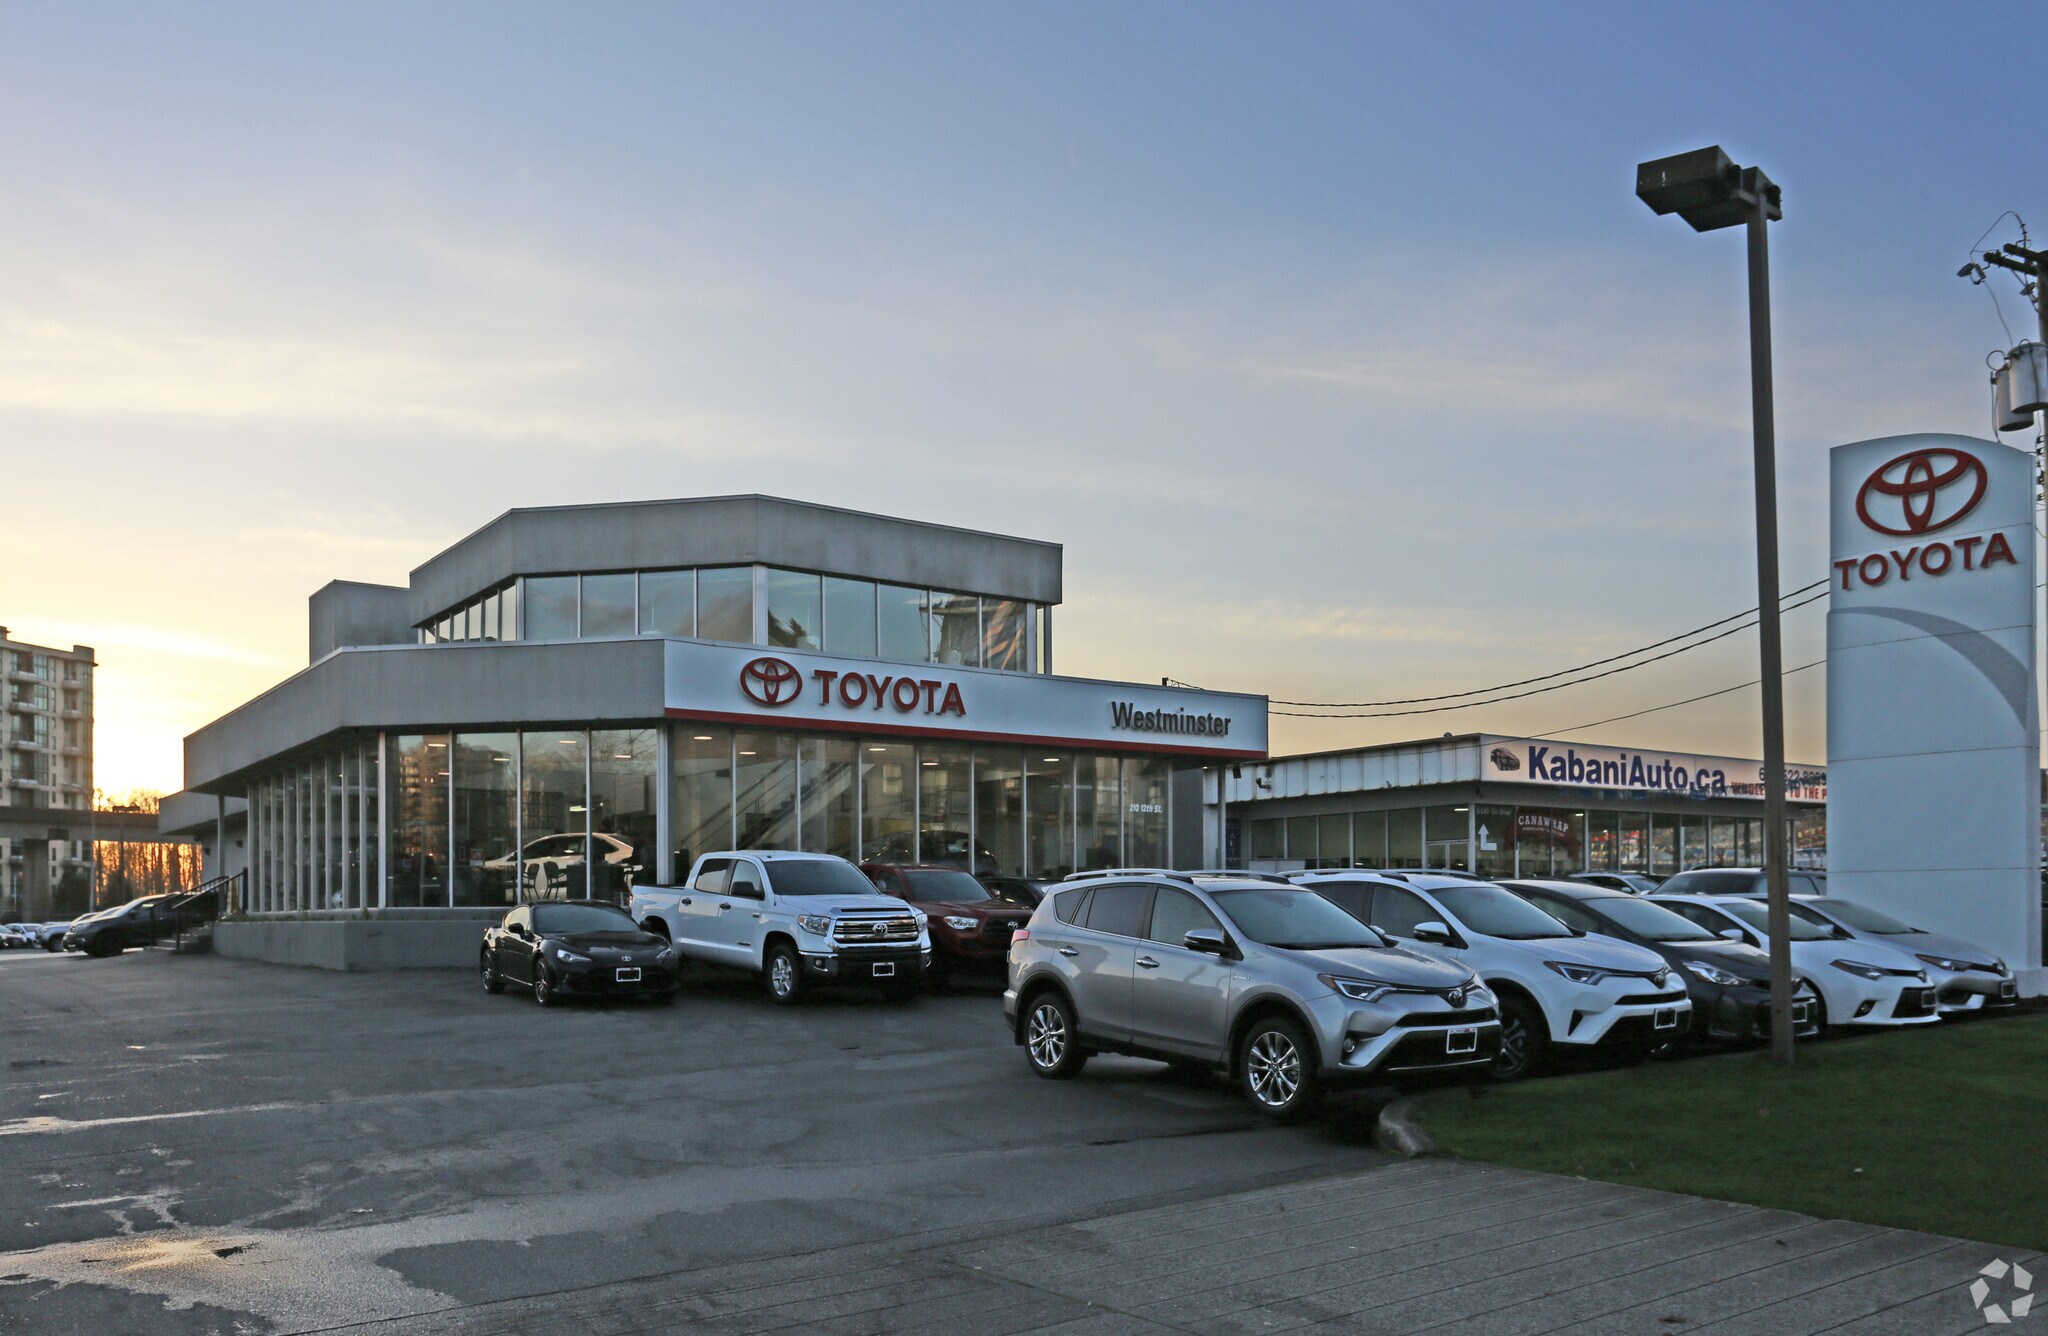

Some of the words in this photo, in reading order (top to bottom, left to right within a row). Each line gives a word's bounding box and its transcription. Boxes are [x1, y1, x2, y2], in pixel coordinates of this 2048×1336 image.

[1834, 532, 2018, 591] TOYOTA
[814, 669, 967, 717] TOYOTA
[1111, 701, 1231, 737] Westminster
[1528, 745, 1727, 795] KabaniAuto.ca
[1129, 803, 1139, 812] 210
[1140, 804, 1153, 813] 12th
[1804, 787, 1819, 799] THE
[1518, 815, 1569, 833] CANAWRAP
